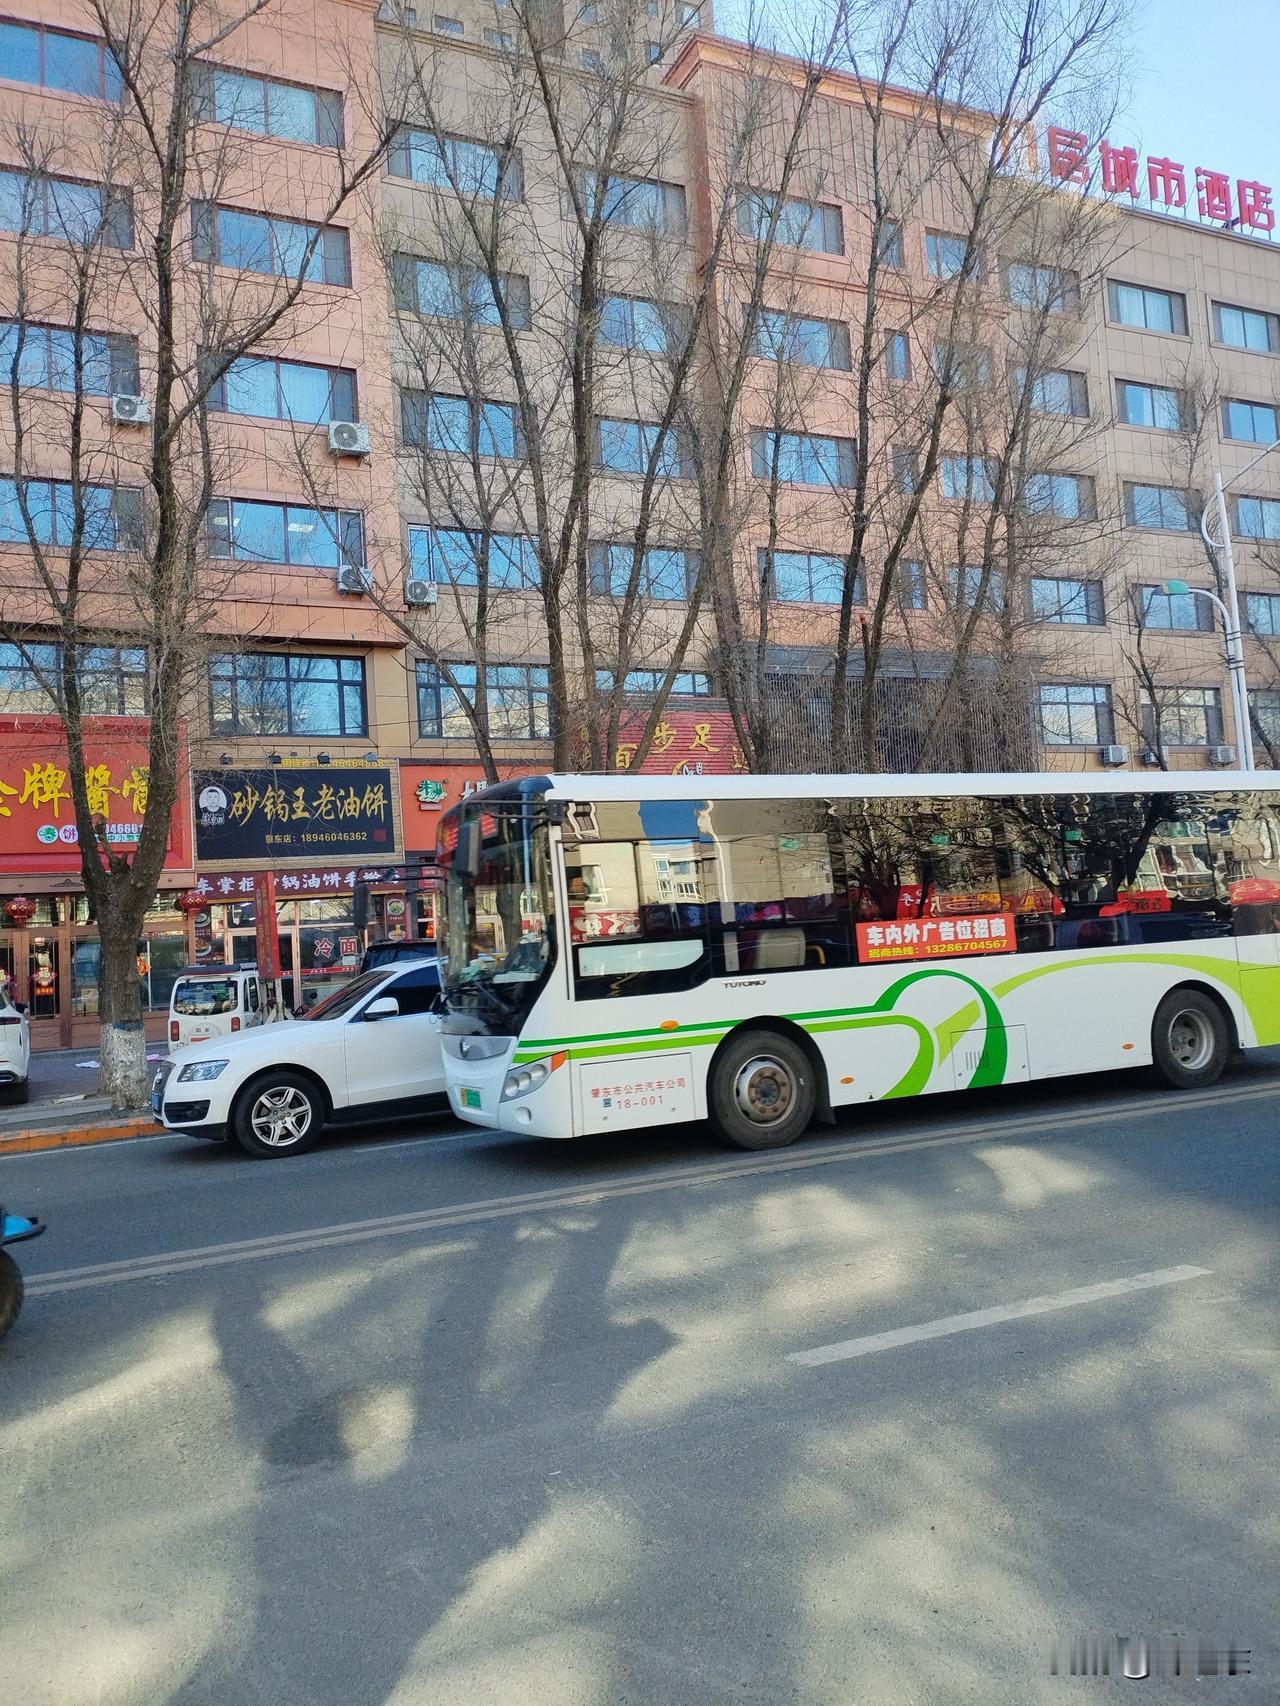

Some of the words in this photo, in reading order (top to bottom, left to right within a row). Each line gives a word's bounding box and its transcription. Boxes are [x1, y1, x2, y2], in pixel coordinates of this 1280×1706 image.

[300, 831, 368, 843] 18946046362
[866, 917, 1006, 946] 车内外广告位招商
[314, 935, 358, 958] 冷面
[924, 939, 1008, 954] 13286704567
[591, 1077, 686, 1098] 肇东市公共汽车公司
[616, 1095, 664, 1110] 18-001
